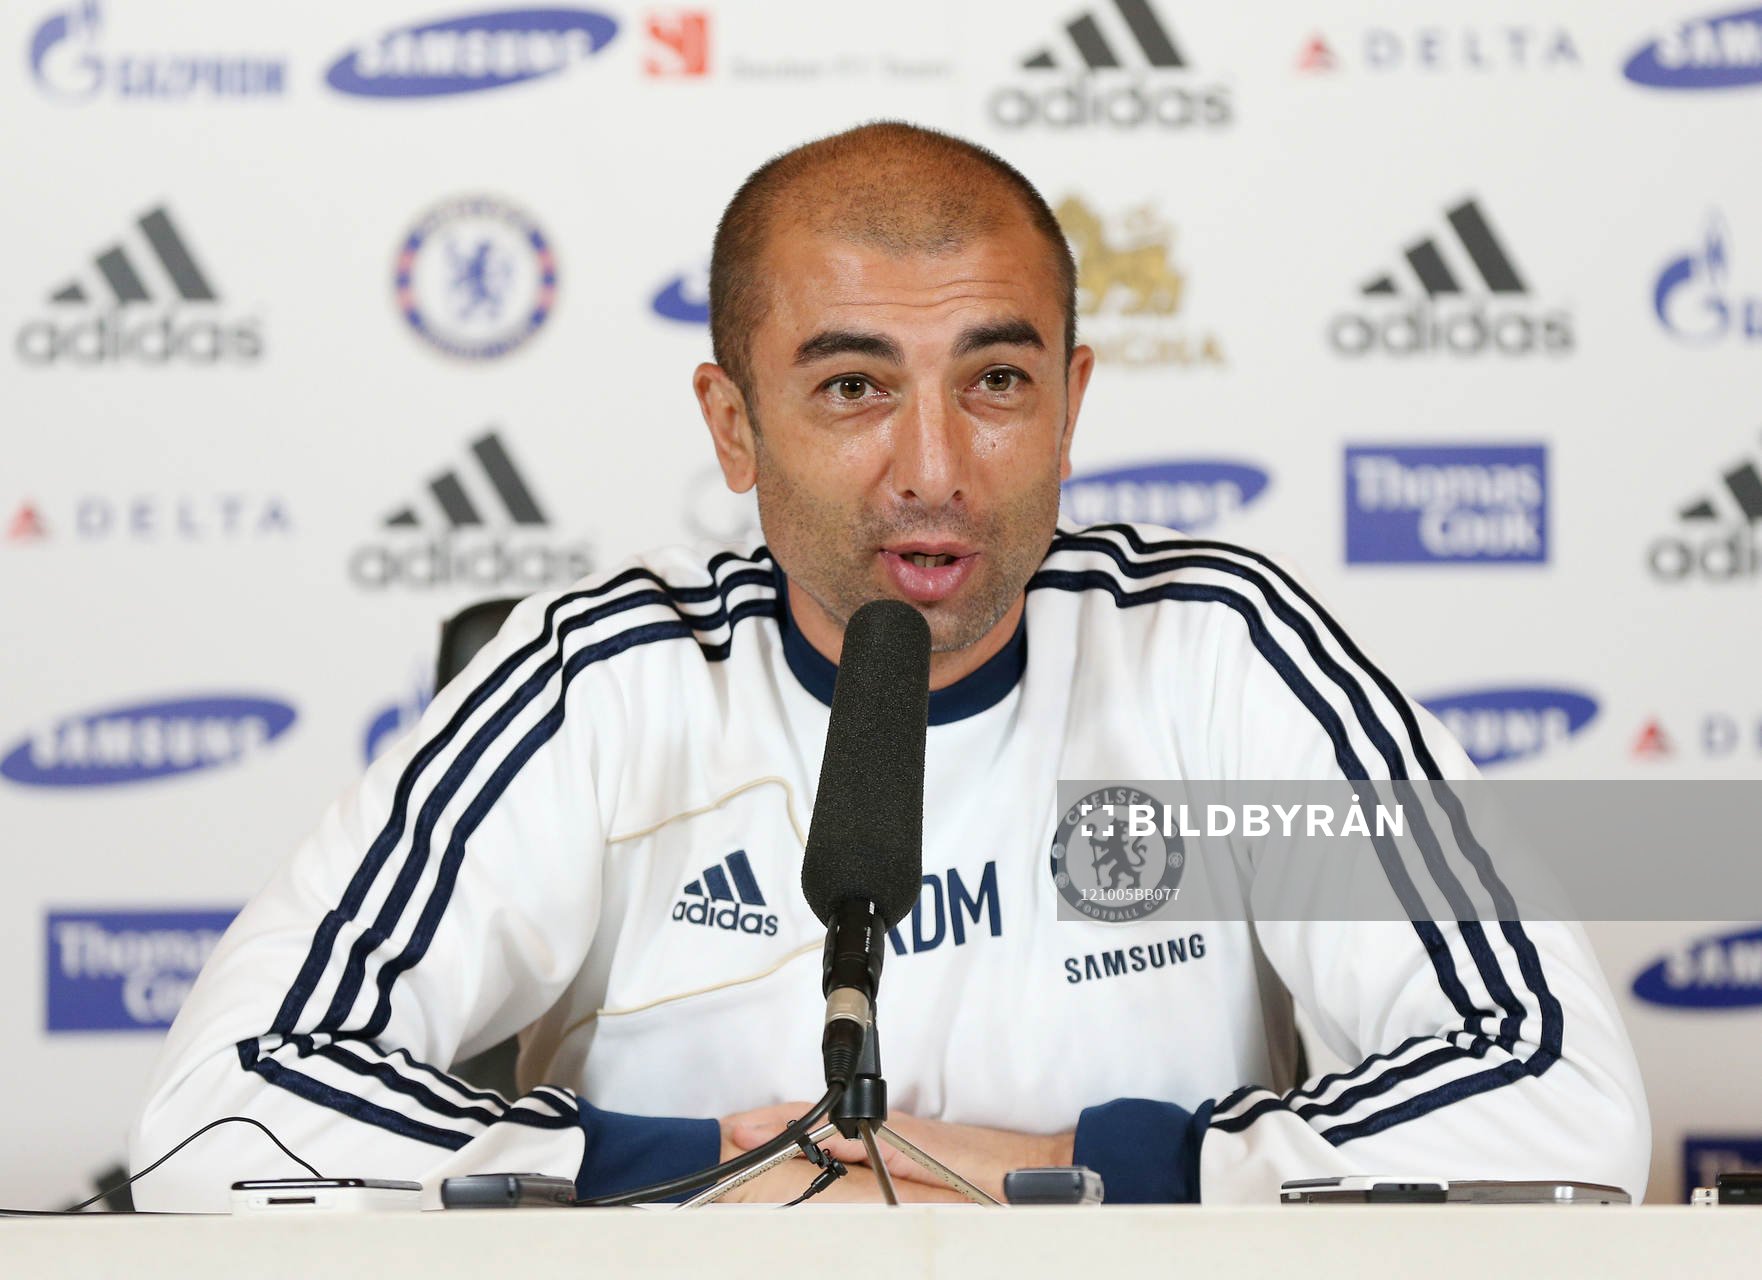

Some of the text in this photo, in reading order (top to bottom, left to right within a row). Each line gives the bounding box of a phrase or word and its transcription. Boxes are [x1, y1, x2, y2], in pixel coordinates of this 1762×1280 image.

[352, 28, 596, 78] SAMSUNG
[1362, 27, 1582, 68] DELTA
[988, 74, 1235, 131] adidas
[16, 311, 265, 366] adidas
[1328, 304, 1576, 358] adidas
[1352, 455, 1543, 513] Thomas
[75, 497, 292, 540] DELTA
[1418, 505, 1542, 558] Cook
[348, 530, 594, 591] adidas
[28, 714, 272, 770] SAMSUNG
[672, 897, 779, 936] adidas
[1075, 901, 1140, 921] FOOTBALL
[1063, 932, 1207, 985] SAMSUNG
